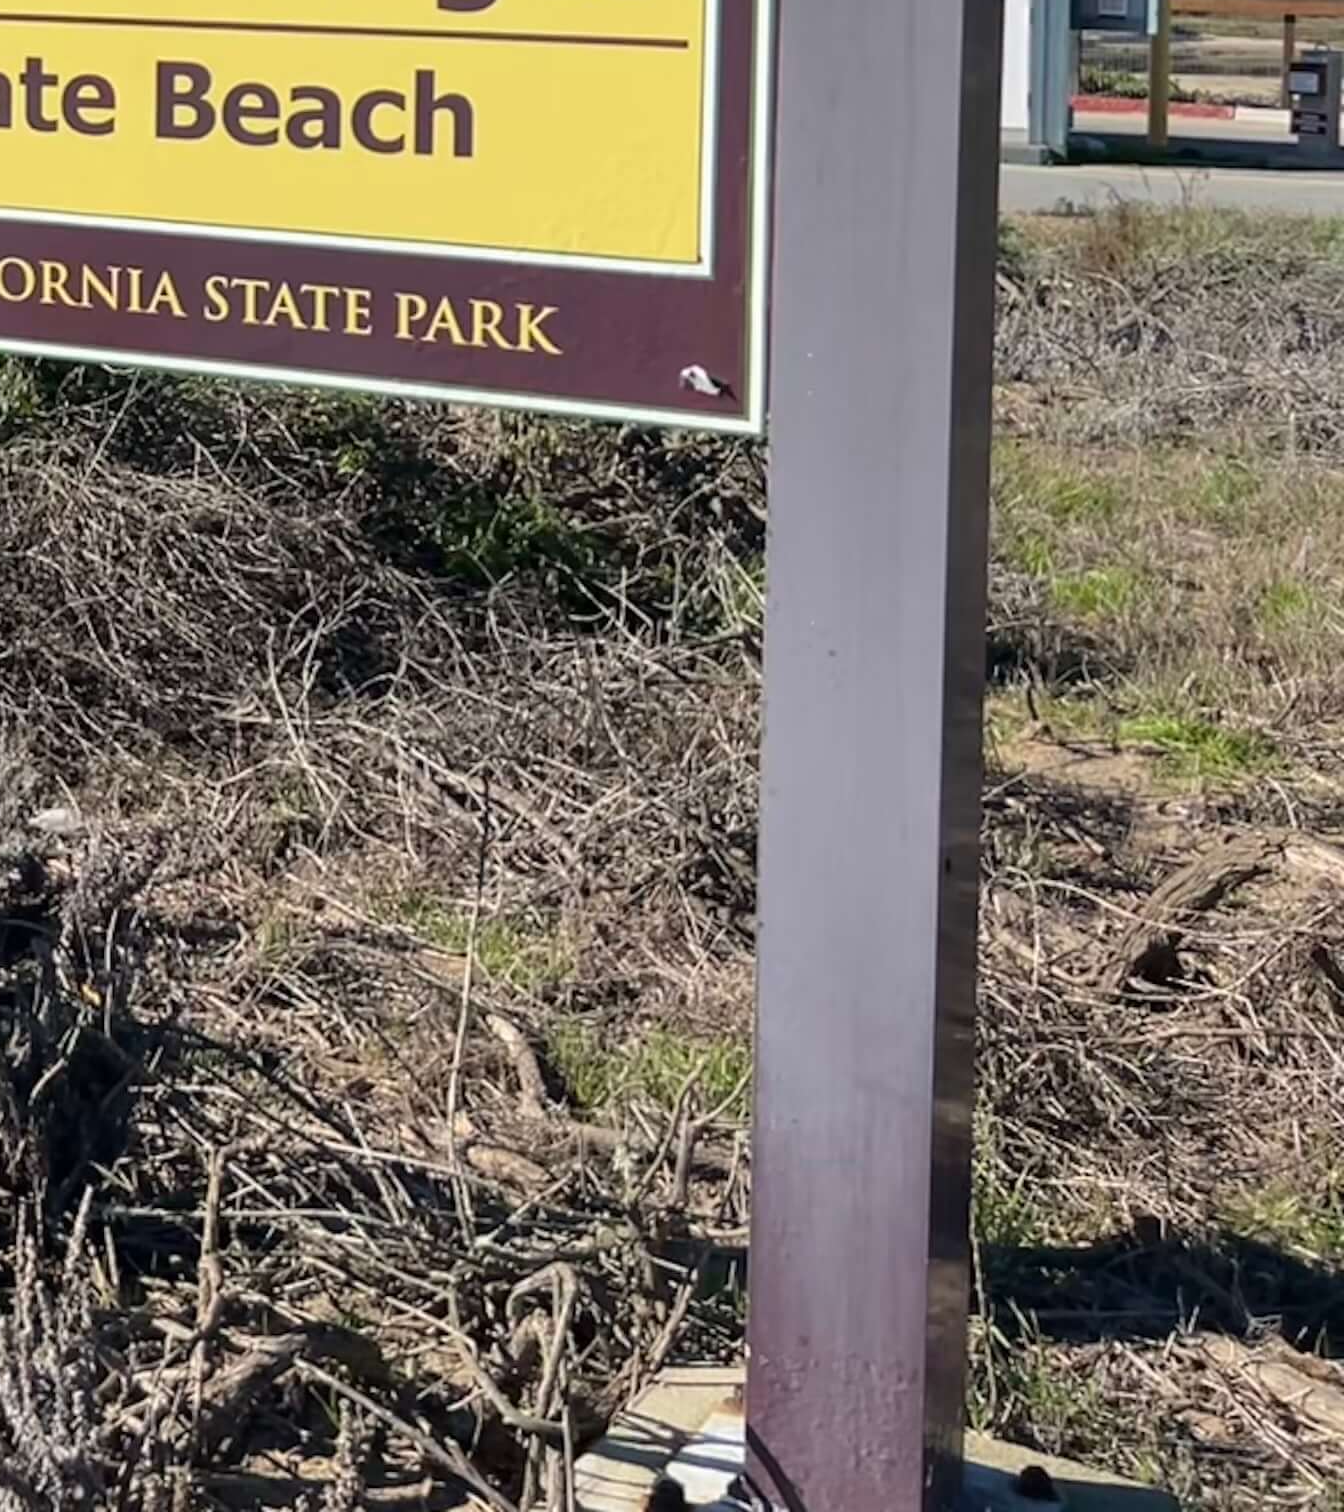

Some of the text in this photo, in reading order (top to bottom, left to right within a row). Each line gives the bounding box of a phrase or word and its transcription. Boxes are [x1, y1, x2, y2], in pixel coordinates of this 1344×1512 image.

[155, 60, 474, 158] Beach
[203, 275, 372, 335] STATE
[394, 292, 563, 355] PARK
